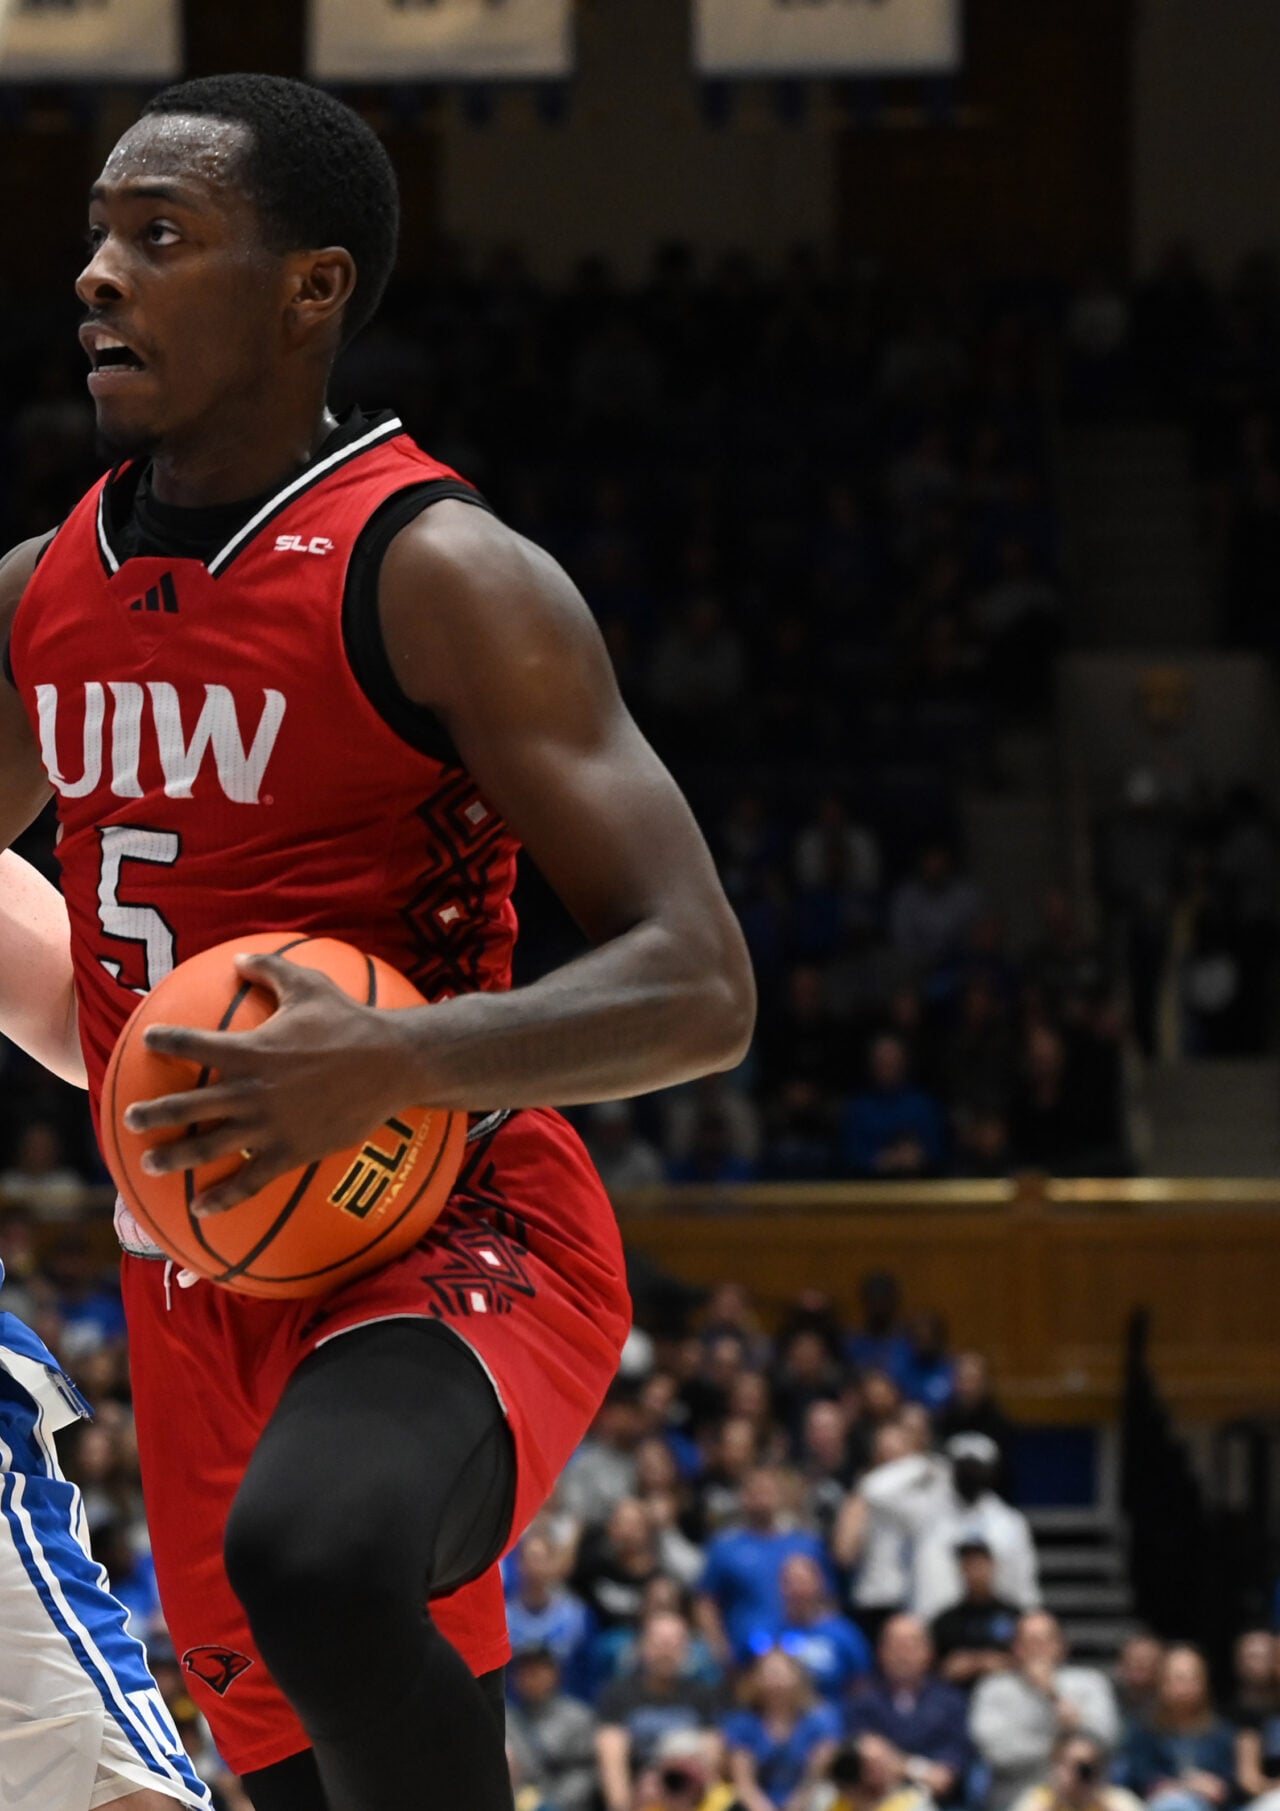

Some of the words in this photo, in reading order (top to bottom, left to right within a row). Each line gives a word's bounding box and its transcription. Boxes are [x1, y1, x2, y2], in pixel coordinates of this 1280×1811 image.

[273, 534, 330, 555] SLC
[34, 681, 287, 804] UIW
[95, 824, 182, 997] 5
[326, 1116, 414, 1219] ELI
